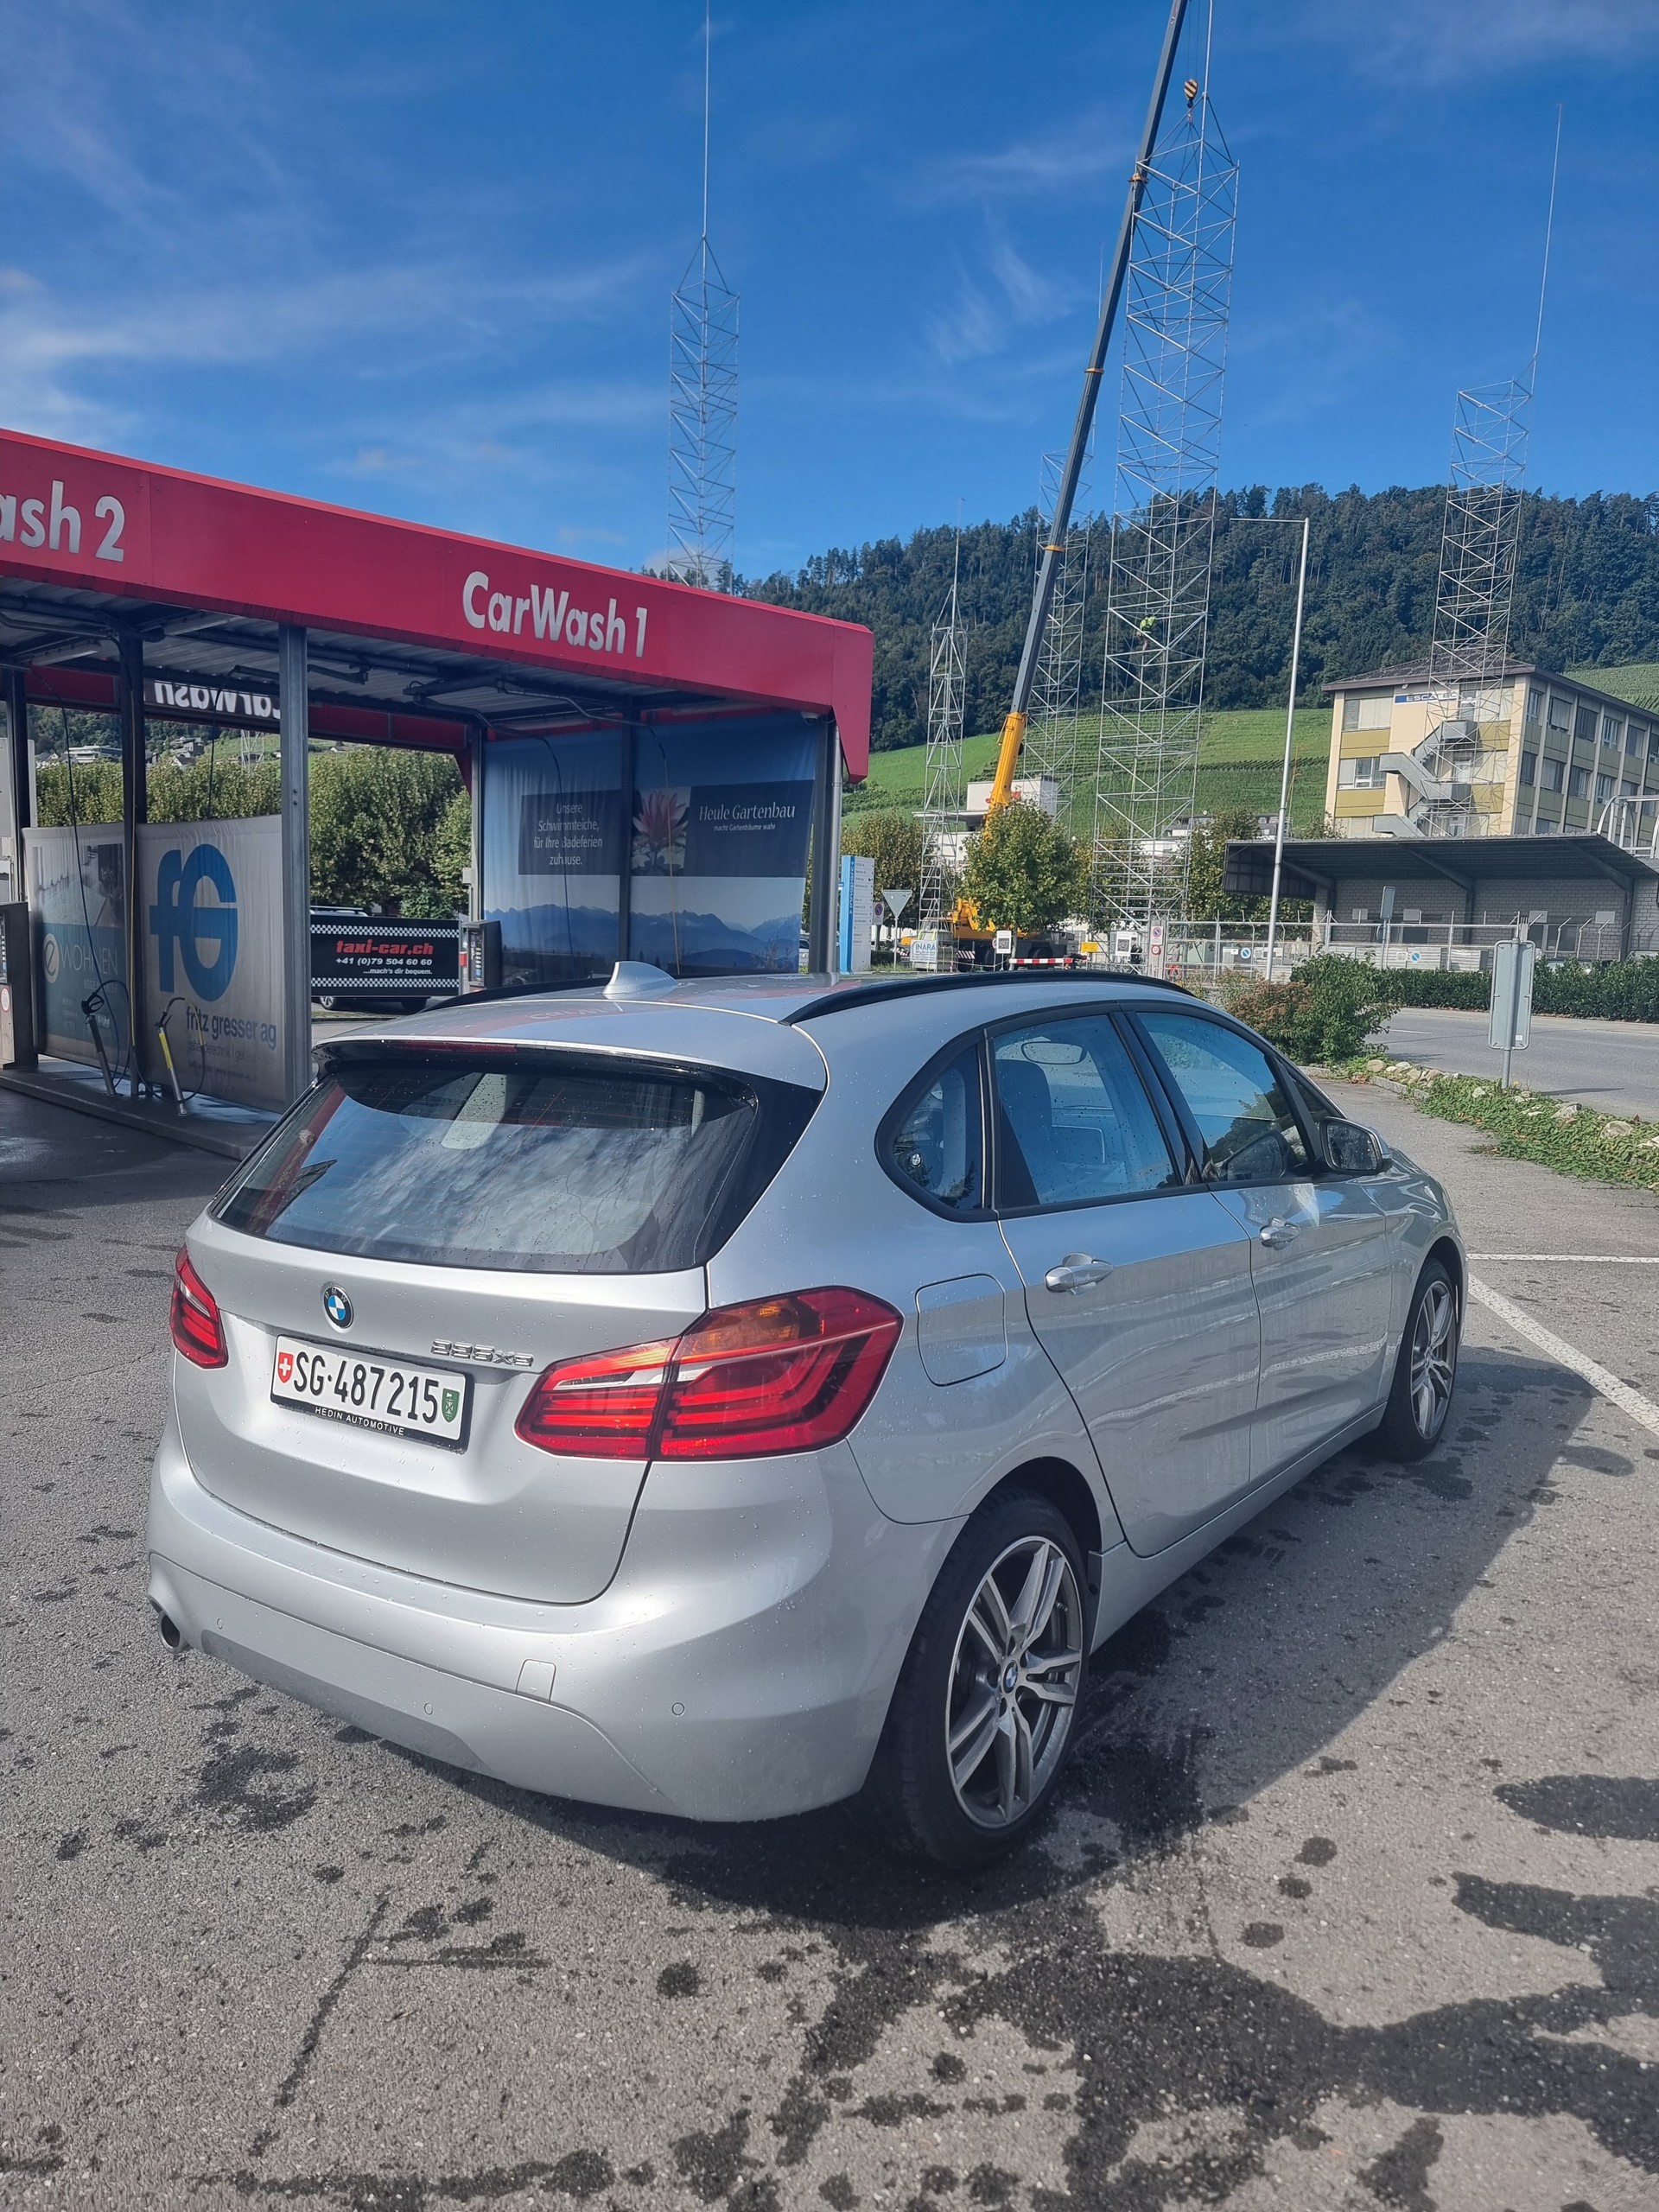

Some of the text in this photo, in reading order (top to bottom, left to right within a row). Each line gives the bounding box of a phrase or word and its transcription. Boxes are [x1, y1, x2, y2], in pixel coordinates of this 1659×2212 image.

[94, 495, 125, 563] 2
[462, 570, 647, 658] CarWash 1
[556, 803, 583, 814] Unsere
[699, 802, 796, 821] Heule Gartenbau
[537, 817, 600, 832] Schwimmteiche,
[534, 835, 603, 849] für Ihre Badeferien
[336, 939, 434, 955] taxi-car.ch
[357, 957, 383, 966] (0)79
[186, 1005, 276, 1052] fritz gresser ag
[315, 1407, 405, 1436] HEDIN AUTOMOTIVE
